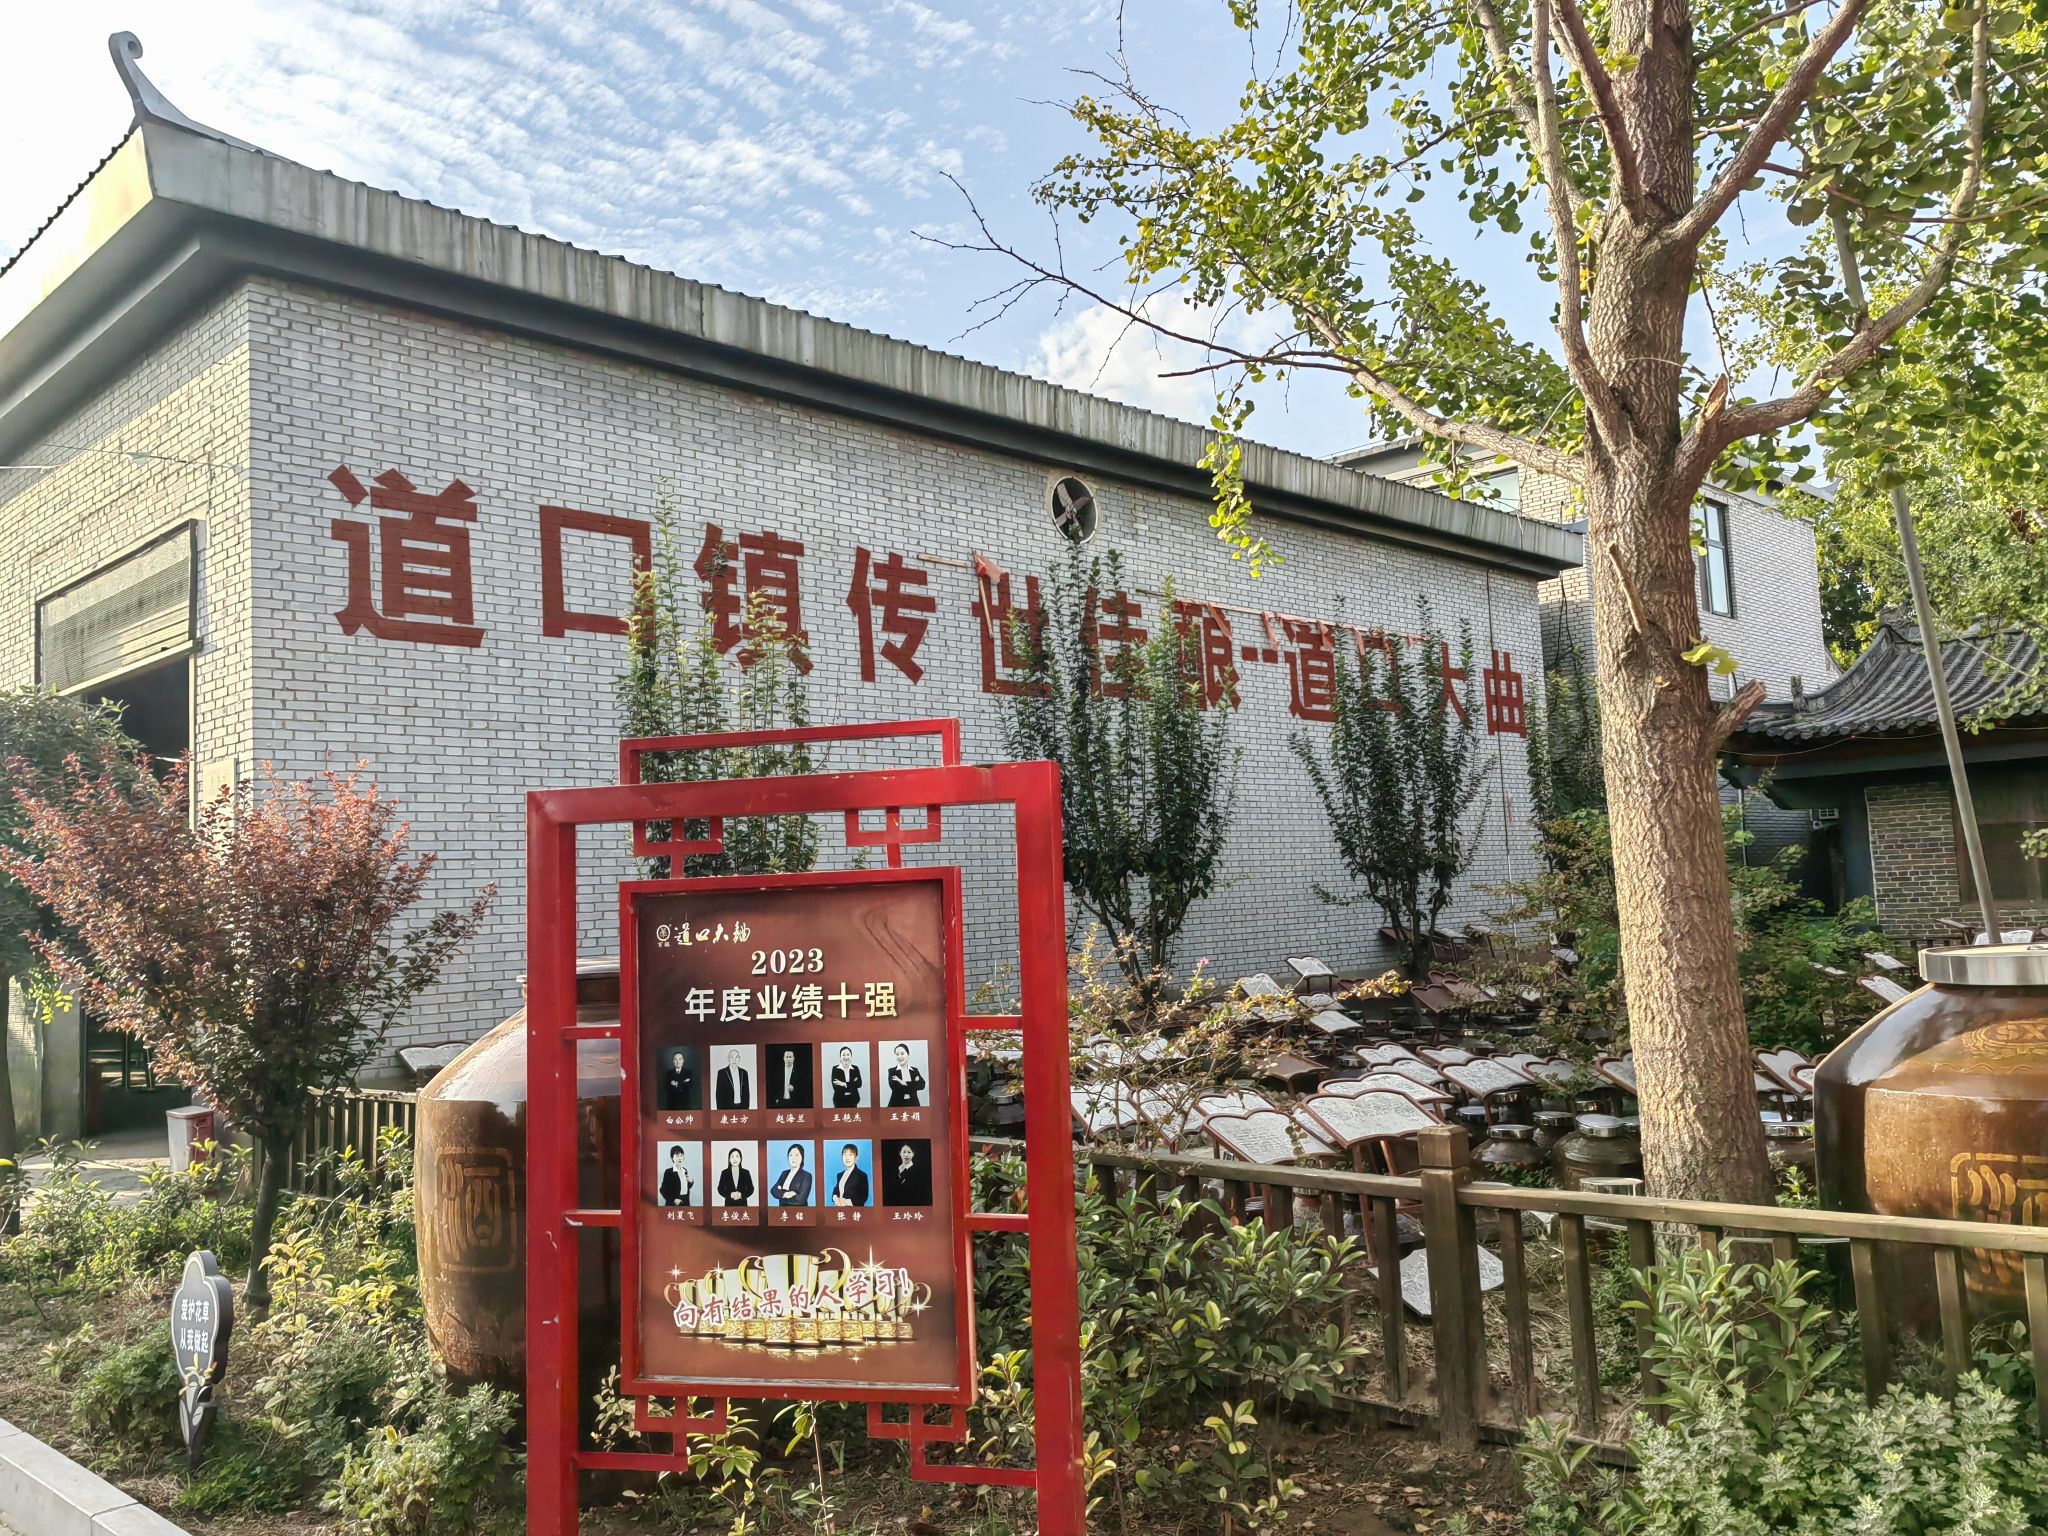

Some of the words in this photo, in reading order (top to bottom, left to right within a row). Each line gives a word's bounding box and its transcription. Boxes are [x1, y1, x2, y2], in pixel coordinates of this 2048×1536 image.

[751, 948, 824, 975] 2023
[684, 982, 898, 1023] 年度业绩十强
[181, 1299, 210, 1323] 爱护花草
